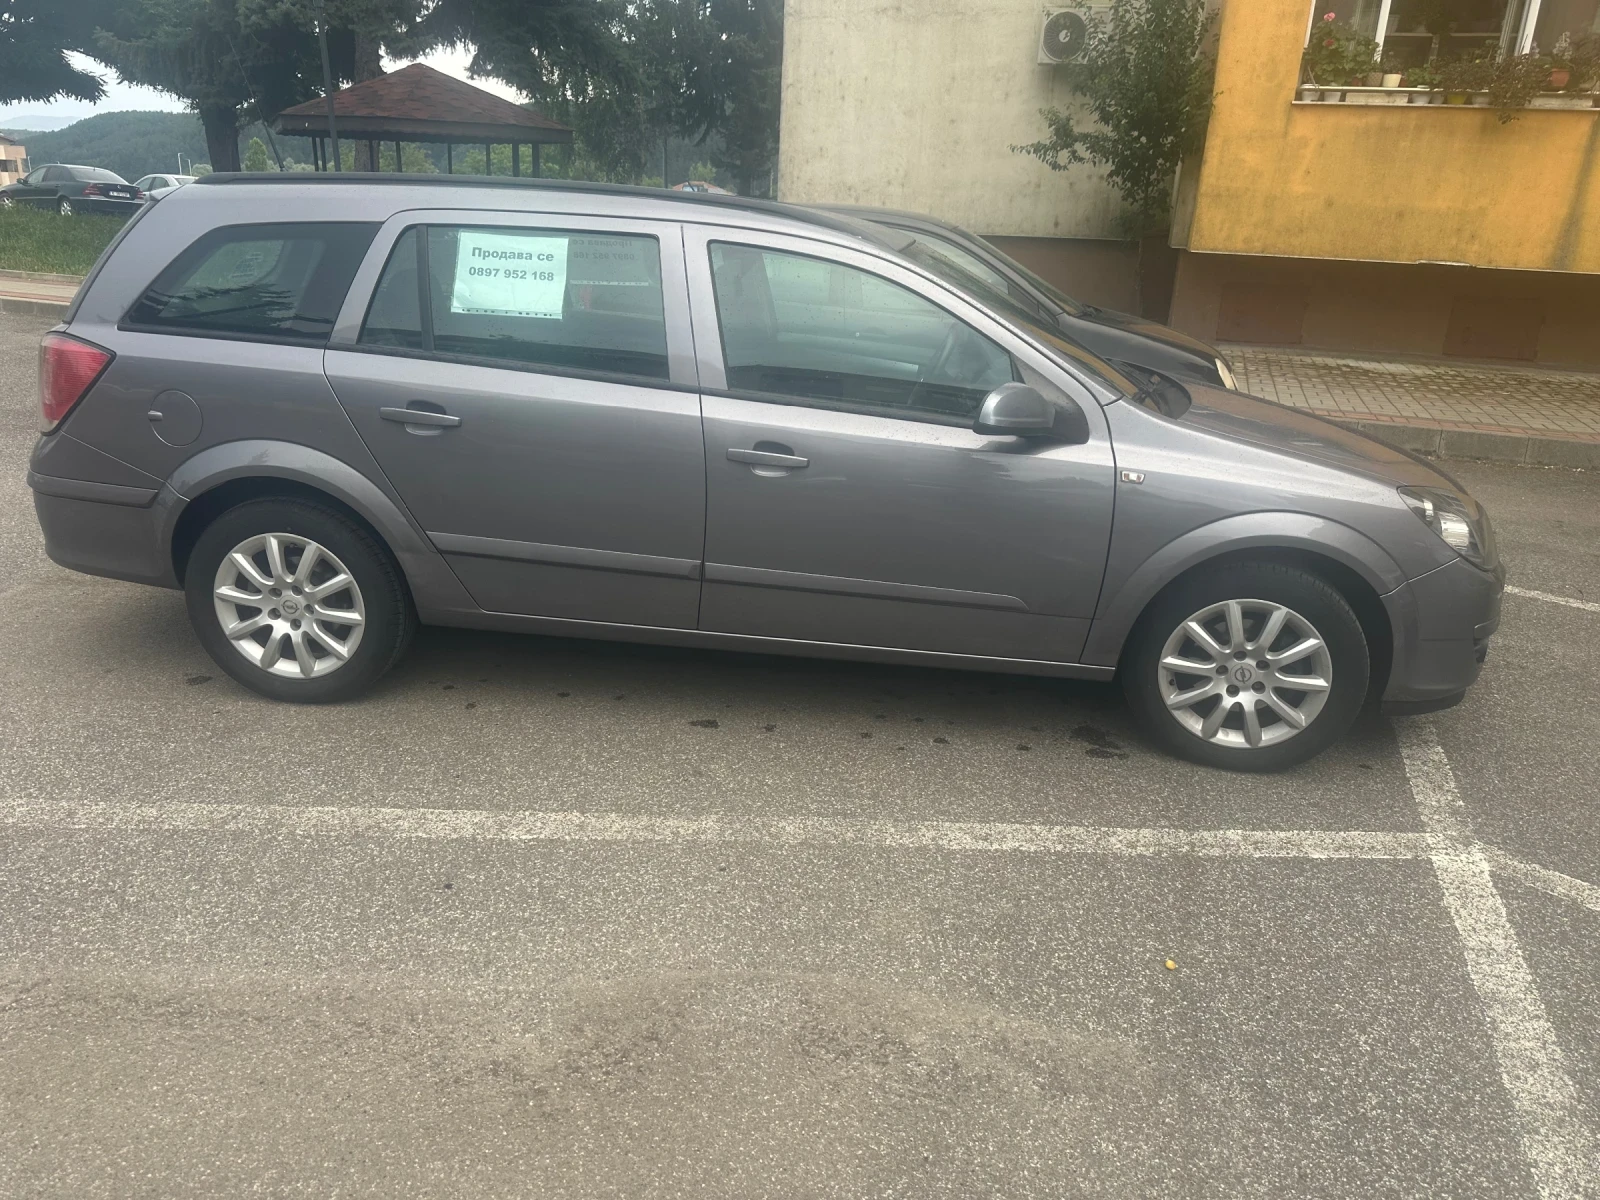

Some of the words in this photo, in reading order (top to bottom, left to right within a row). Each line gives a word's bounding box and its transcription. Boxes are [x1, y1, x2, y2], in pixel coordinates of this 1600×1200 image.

[471, 246, 533, 260] Продава
[537, 252, 554, 261] се
[468, 266, 500, 277] 0897
[504, 269, 527, 280] 952
[531, 271, 554, 281] 168
